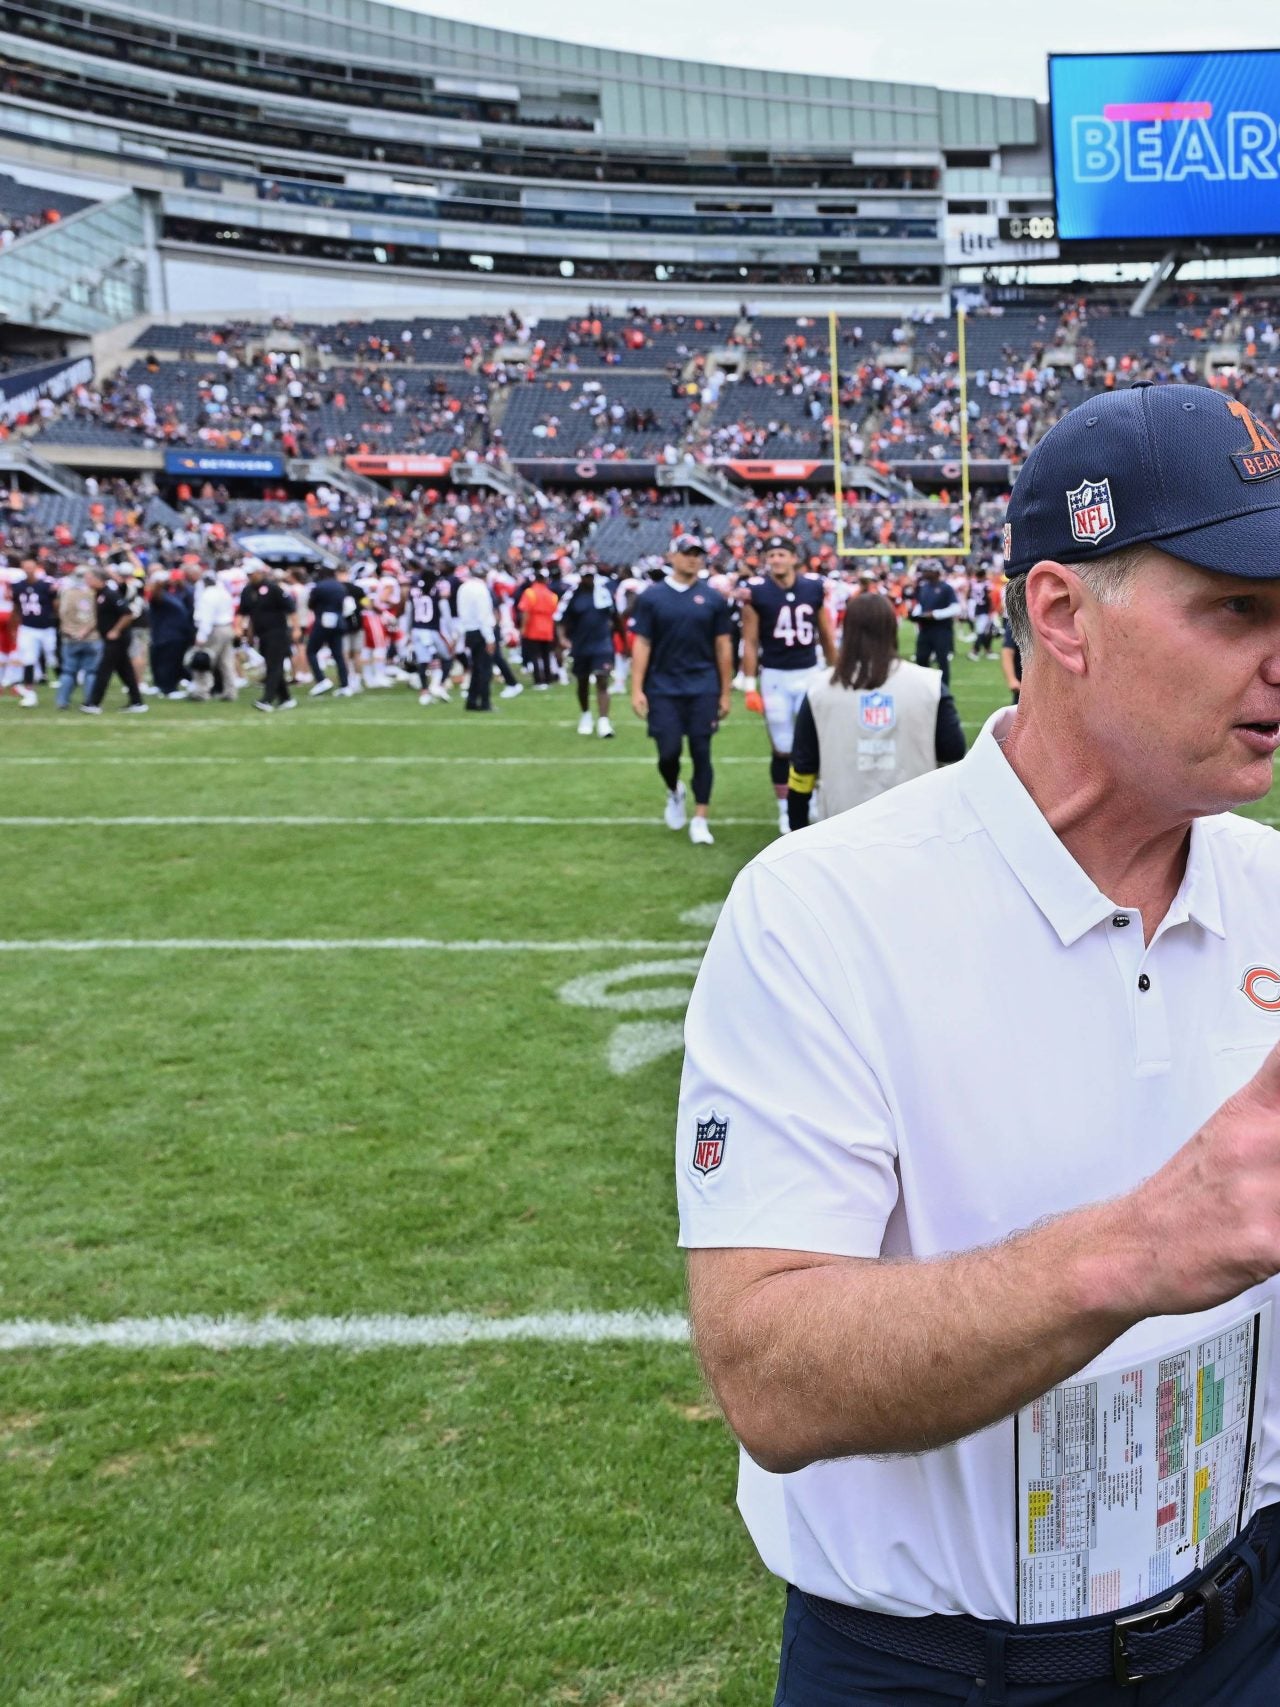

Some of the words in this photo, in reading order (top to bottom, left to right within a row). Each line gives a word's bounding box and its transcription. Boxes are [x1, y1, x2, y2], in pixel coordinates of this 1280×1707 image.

[1075, 505, 1109, 535] NFL
[773, 603, 815, 647] 46
[863, 707, 892, 726] NFL
[695, 1141, 721, 1169] NFL
